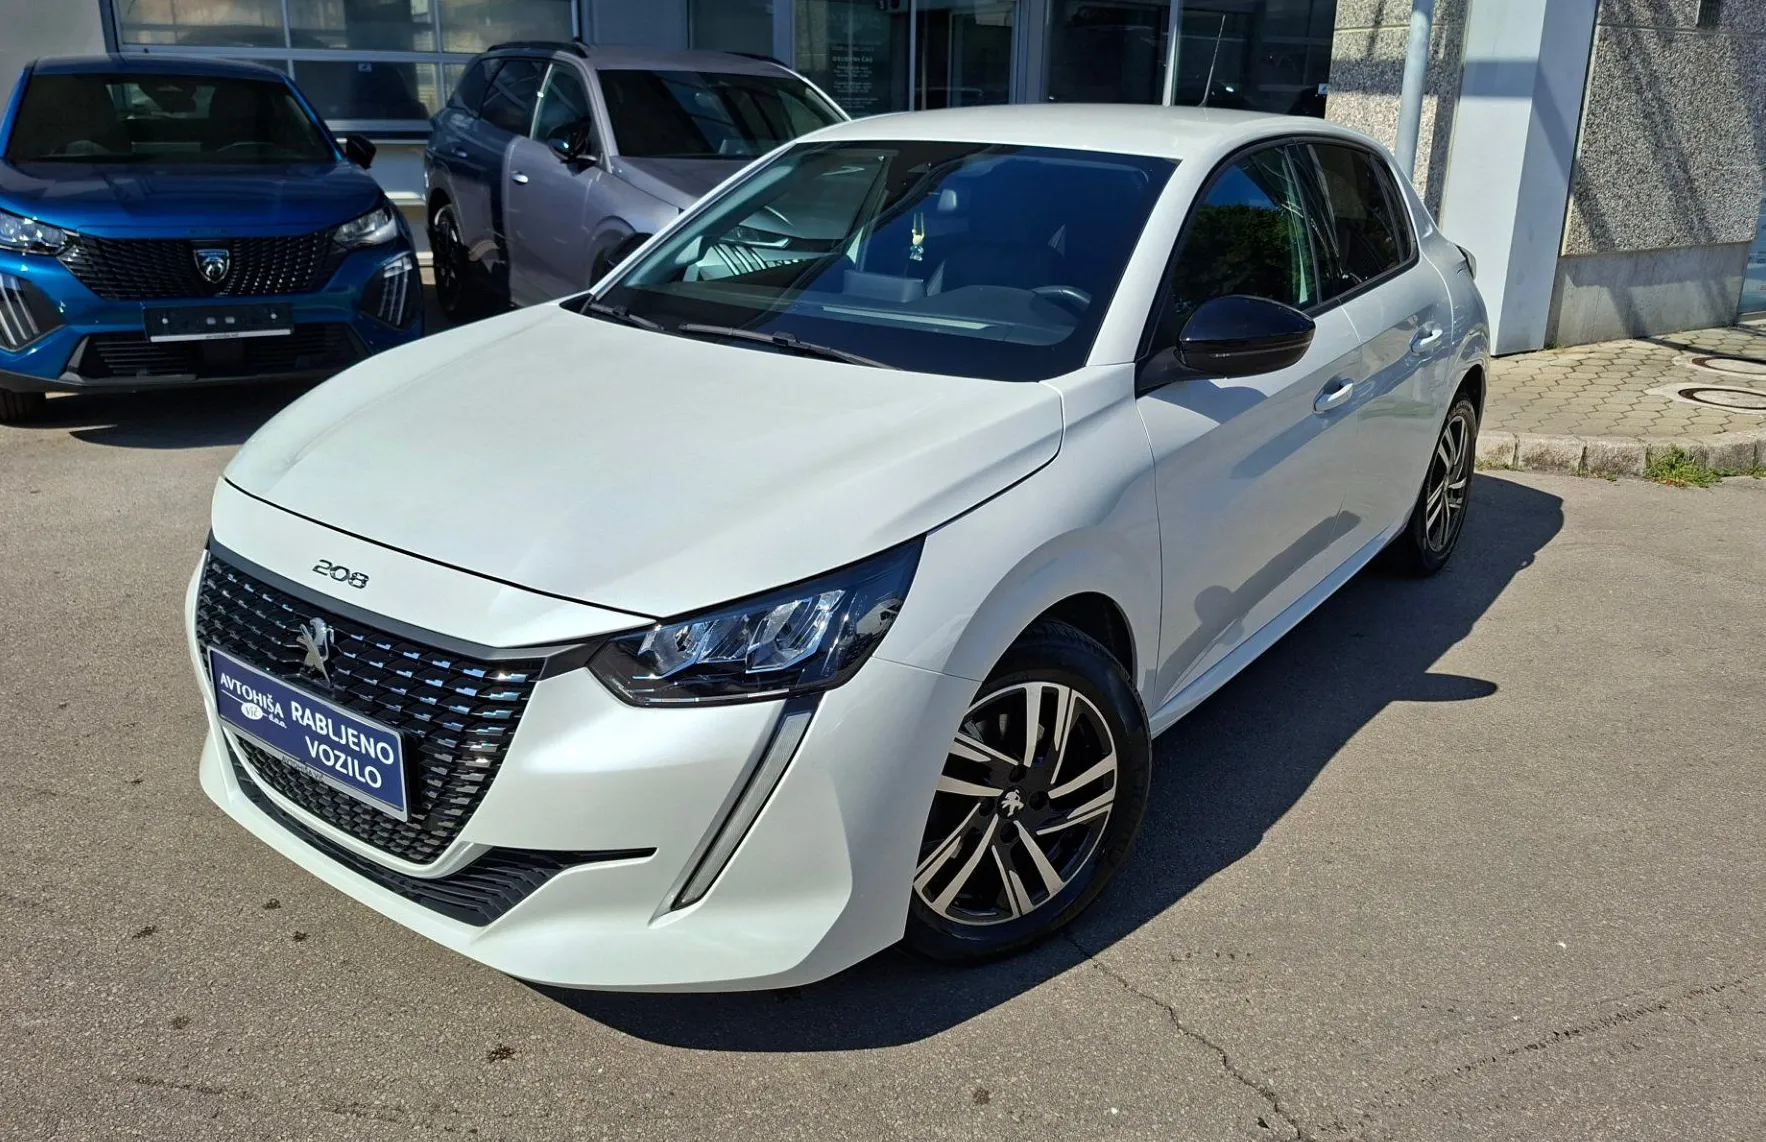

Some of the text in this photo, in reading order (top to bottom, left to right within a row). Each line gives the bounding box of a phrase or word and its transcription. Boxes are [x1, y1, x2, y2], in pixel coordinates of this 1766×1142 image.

[312, 559, 369, 589] 208
[220, 672, 285, 719] AVTOHIŠA
[290, 701, 395, 765] RABLJENO
[305, 736, 382, 789] VOZILO
